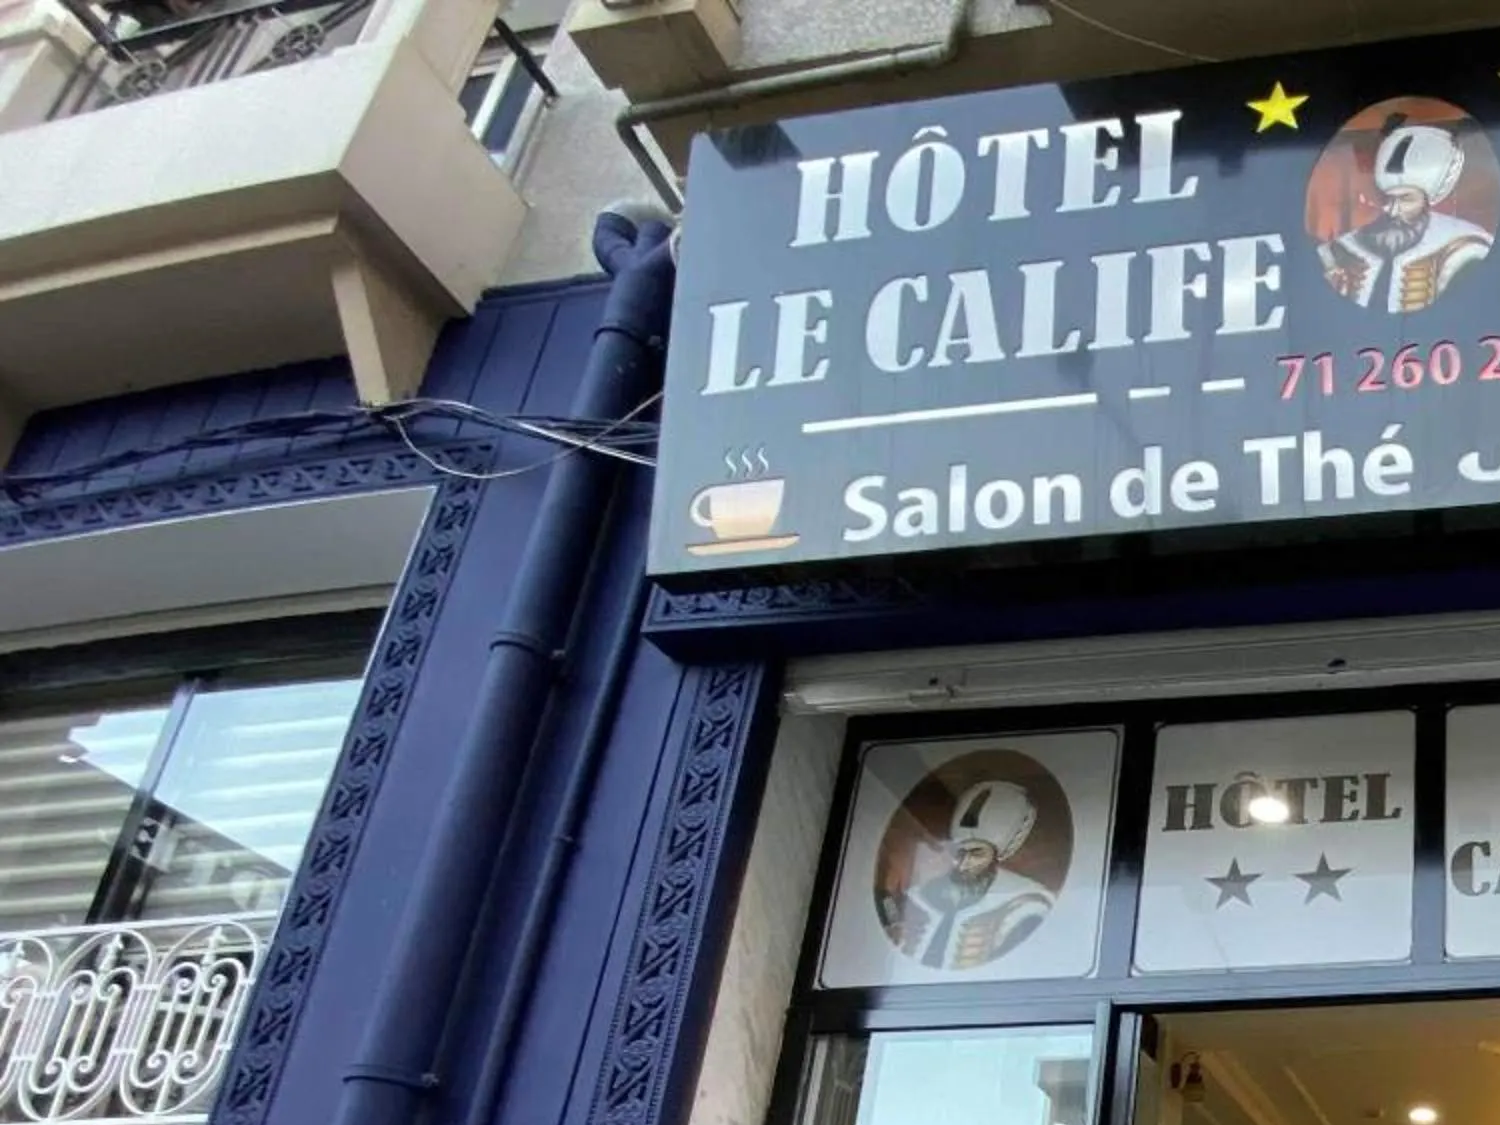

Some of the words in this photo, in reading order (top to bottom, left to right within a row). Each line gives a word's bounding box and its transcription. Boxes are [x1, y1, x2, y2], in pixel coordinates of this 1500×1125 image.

[790, 109, 1199, 248] HÔTEL
[700, 289, 833, 396] LE
[866, 233, 1286, 374] CALIFE
[1276, 351, 1334, 400] 71
[1357, 341, 1462, 393] 260
[842, 463, 1082, 542] Salon
[1109, 446, 1219, 516] de
[1243, 424, 1414, 506] Thé
[1162, 772, 1402, 832] HÔTEL
